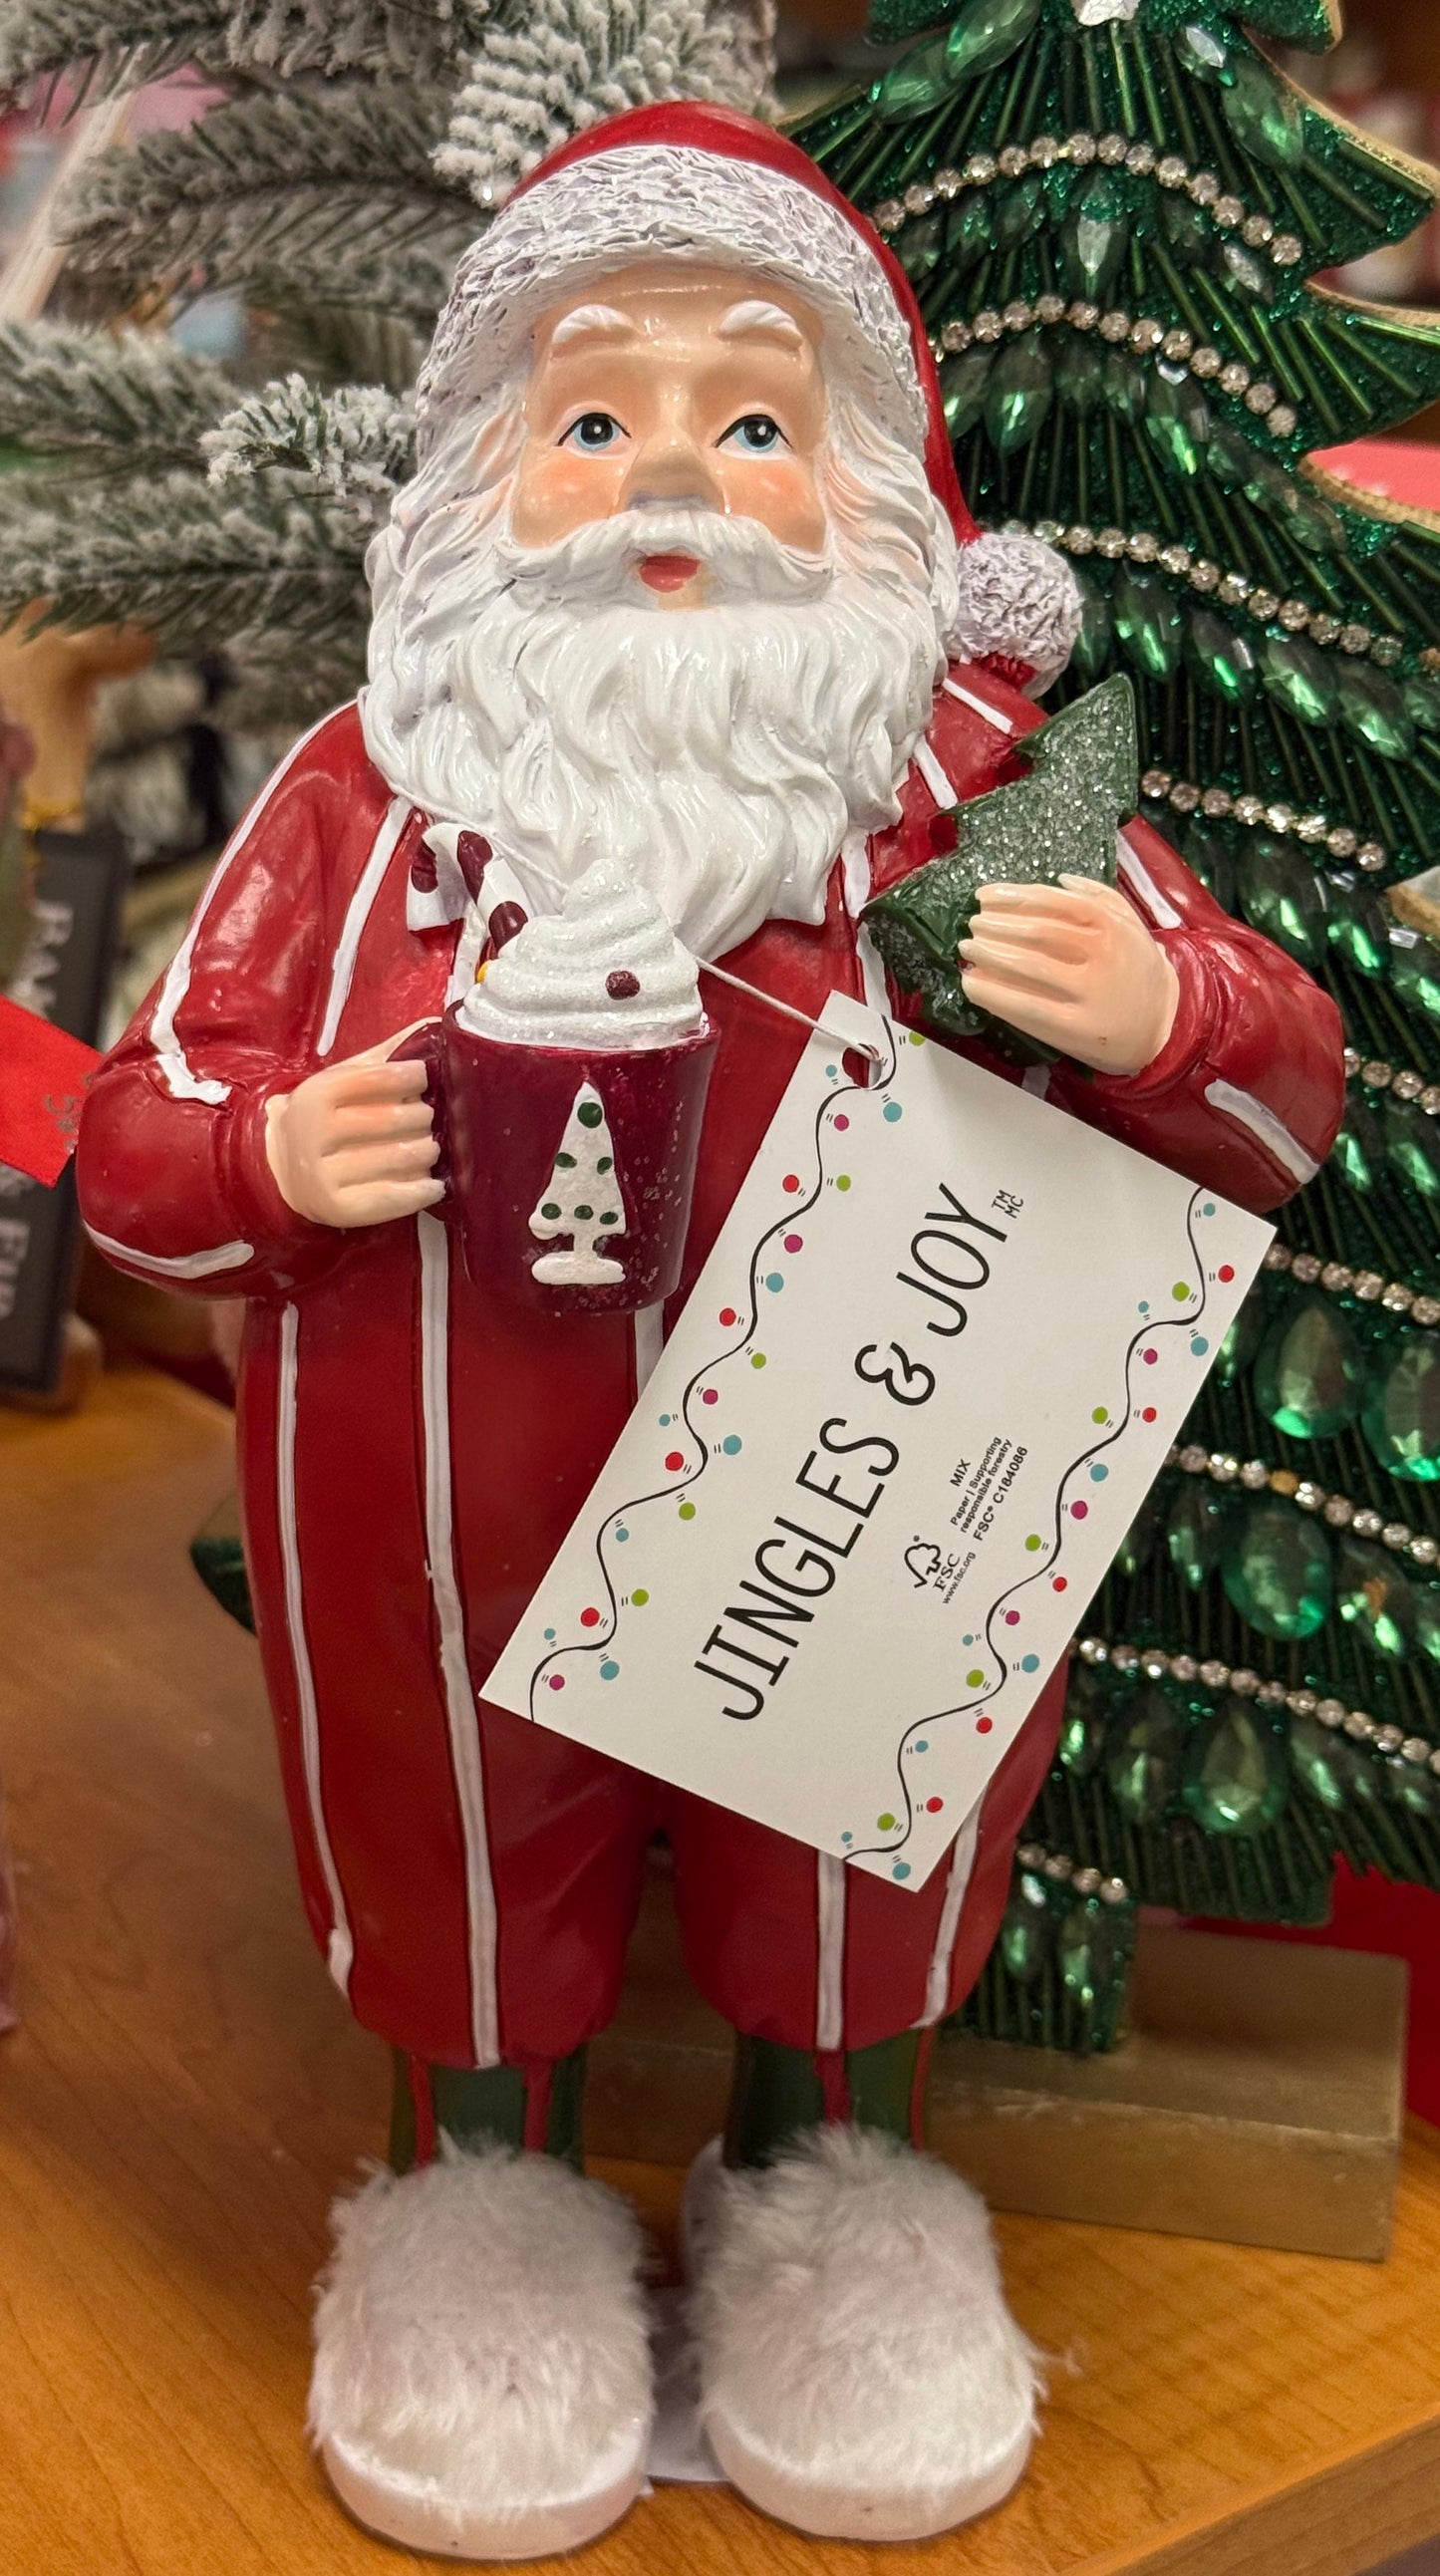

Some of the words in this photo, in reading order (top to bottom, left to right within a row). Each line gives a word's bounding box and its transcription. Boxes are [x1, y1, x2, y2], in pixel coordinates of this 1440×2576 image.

[993, 1190, 1011, 1210] TM
[1006, 1195, 1024, 1219] MC
[694, 1417, 900, 1721] JINGLES
[854, 1341, 936, 1406] &
[896, 1182, 1008, 1337] JOY
[950, 1459, 971, 1487] MIX
[993, 1446, 1027, 1504] C184086
[950, 1495, 971, 1527] Paper
[970, 1436, 1002, 1489] Supporting
[961, 1477, 992, 1533] responsible
[989, 1438, 1012, 1481] forestry
[933, 1553, 960, 1591] FSC
[943, 1551, 977, 1604] www.fsc.org
